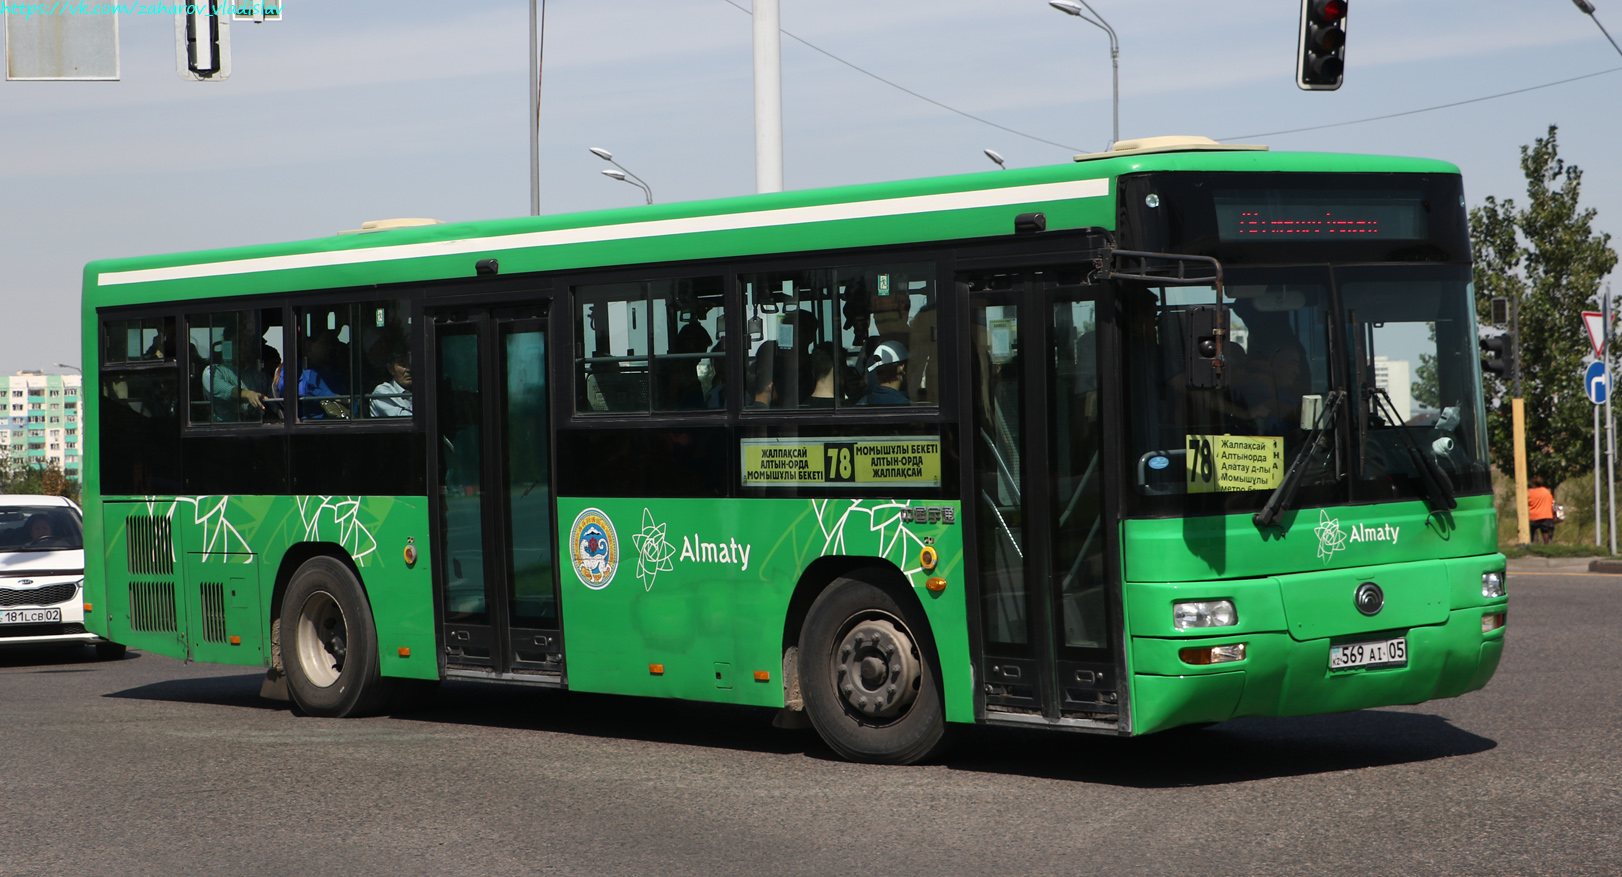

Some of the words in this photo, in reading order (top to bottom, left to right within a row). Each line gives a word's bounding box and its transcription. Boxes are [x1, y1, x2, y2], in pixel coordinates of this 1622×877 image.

[856, 445, 910, 456] МОМЫШҰЛЫ
[911, 443, 938, 454] БЕКЕТІ
[1221, 439, 1266, 451] Жалпақсай
[761, 446, 807, 459] ЖАЛПАҚСАЙ
[1221, 451, 1267, 463] Алтынорда
[760, 459, 809, 470] АЛТЫН-ОРДА
[826, 447, 853, 480] 78
[871, 456, 923, 467] АЛТЫН-ОРДА
[1188, 438, 1213, 483] 78
[872, 466, 923, 479] ЖАЛПАҚСАЙ
[1221, 462, 1249, 473] Алатау
[747, 470, 797, 480] МОМЫШҰЛЫ
[798, 470, 823, 480] БЕКЕТІ
[1220, 473, 1269, 485] Момышұлы
[1349, 522, 1400, 545] Almaty
[679, 532, 751, 571] Almaty
[45, 610, 59, 621] 02
[1342, 645, 1364, 665] 569
[1368, 647, 1382, 662] AI
[1388, 641, 1405, 659] 05
